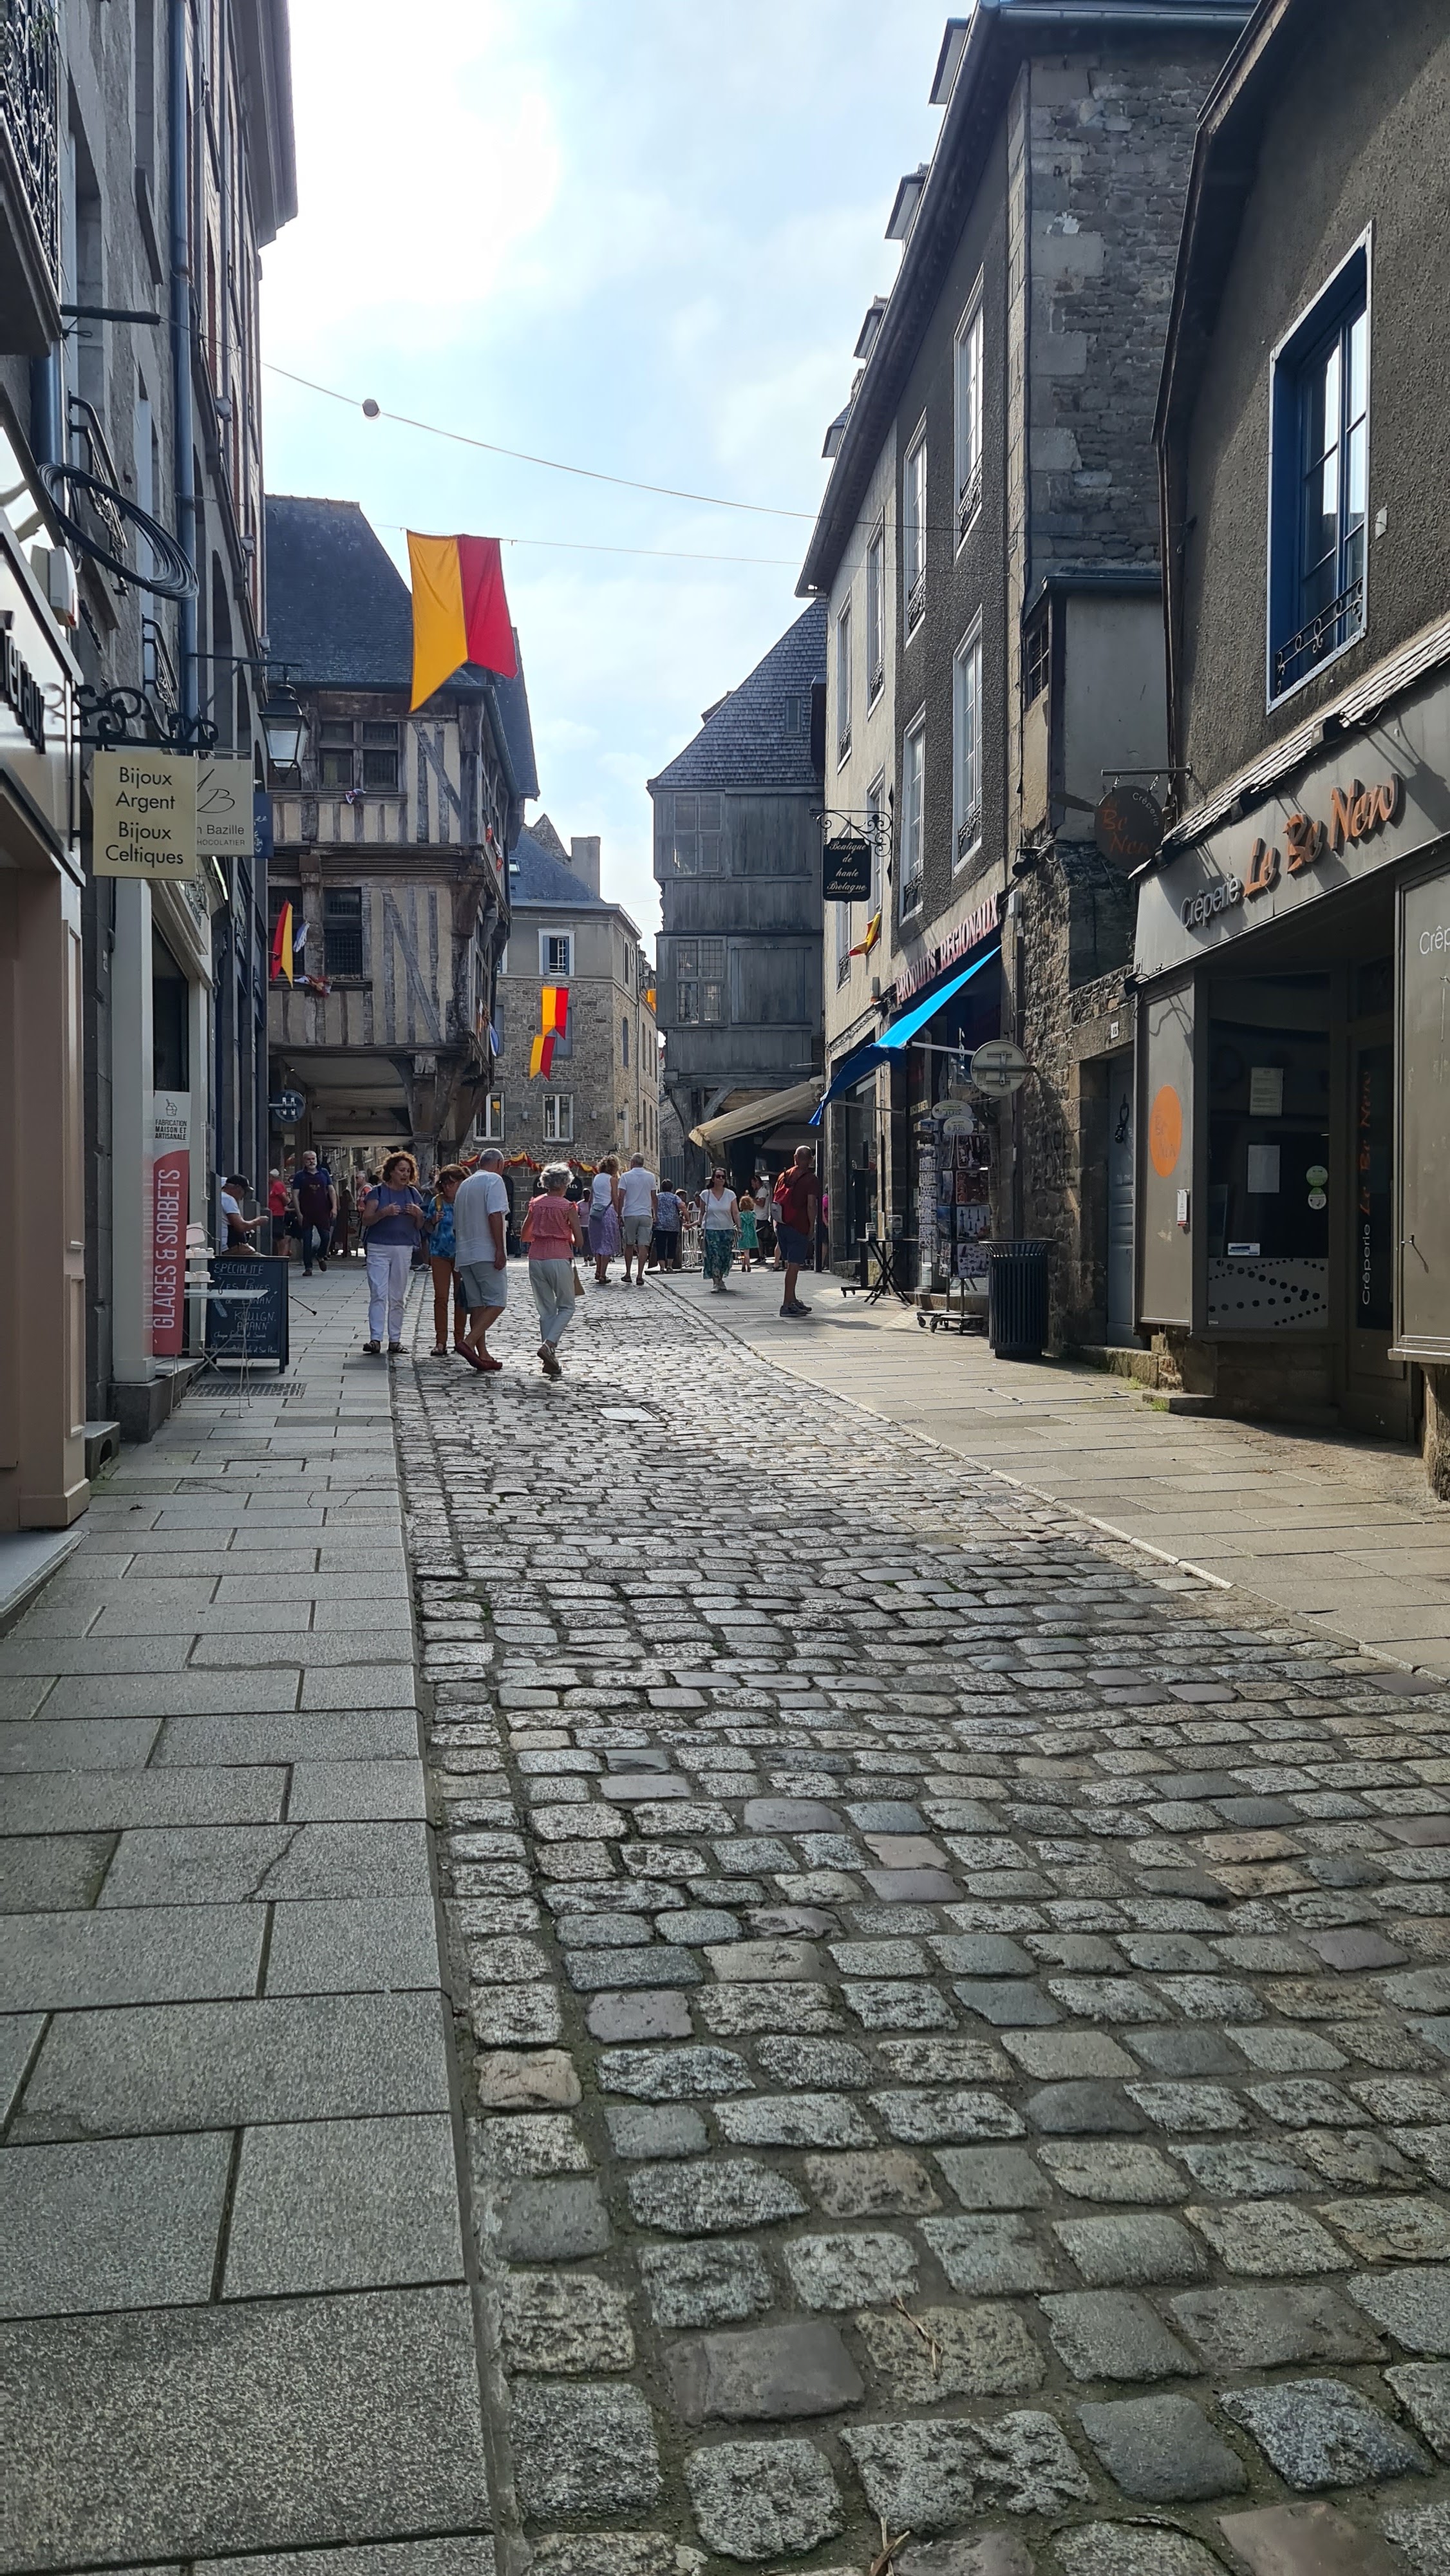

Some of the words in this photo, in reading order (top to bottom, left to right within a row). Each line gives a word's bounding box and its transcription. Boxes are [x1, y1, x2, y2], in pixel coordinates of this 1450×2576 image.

[120, 766, 173, 789] Bijoux
[115, 790, 176, 813] Argent
[119, 821, 172, 844] Bijoux
[207, 824, 245, 835] Bazille
[106, 843, 184, 868] Celtiques
[829, 840, 867, 854] Boutique
[842, 853, 852, 863] de
[1180, 873, 1242, 929] Crêperie
[1243, 838, 1277, 898] Le
[1330, 773, 1398, 851] New
[836, 867, 859, 877] haute
[827, 880, 867, 894] Bretagne
[895, 947, 937, 1005] PRODUITS
[939, 889, 999, 971] REGIONAUX
[156, 1169, 180, 1245] SORBETS
[156, 1249, 178, 1260] &
[153, 1265, 177, 1329] GLACES
